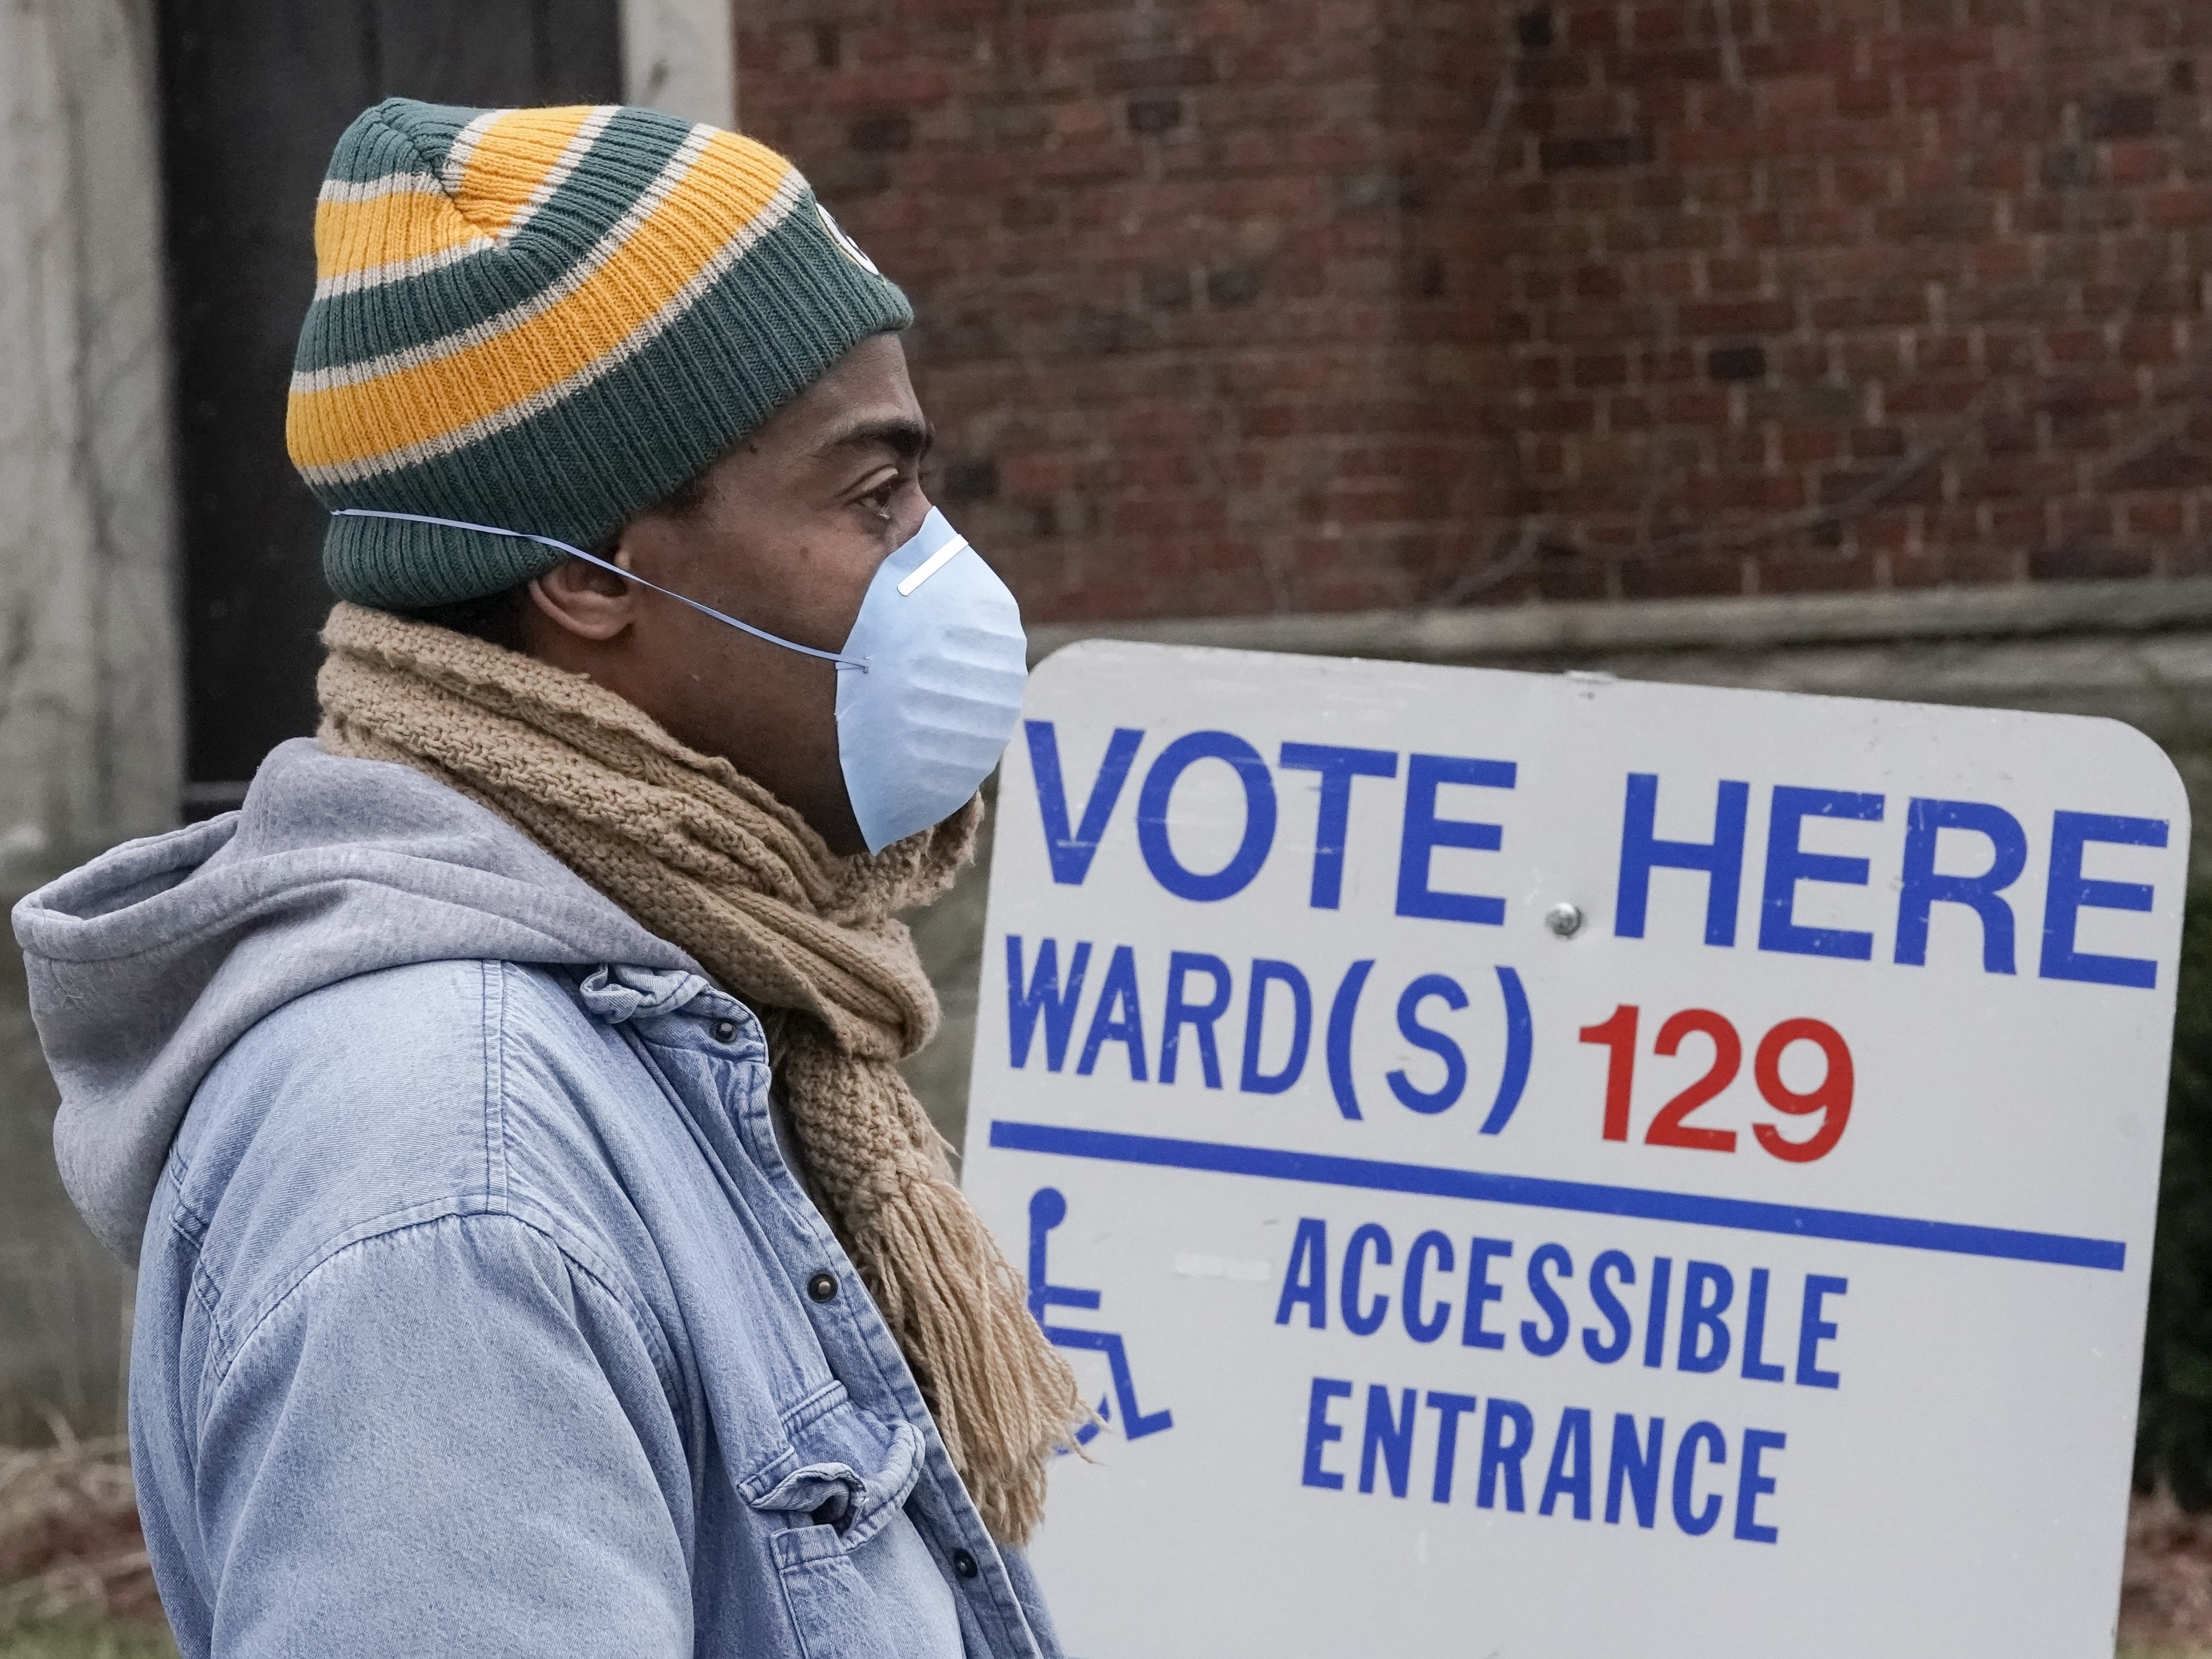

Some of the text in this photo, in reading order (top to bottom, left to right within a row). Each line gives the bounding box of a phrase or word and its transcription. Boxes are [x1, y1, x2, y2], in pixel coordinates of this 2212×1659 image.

[1024, 721, 2170, 989] VOTE HERE
[1006, 935, 1855, 1163] WARD(S) 129
[1275, 1217, 1848, 1390] ACCESSIBLE
[1302, 1377, 1786, 1544] ENTRANCE
